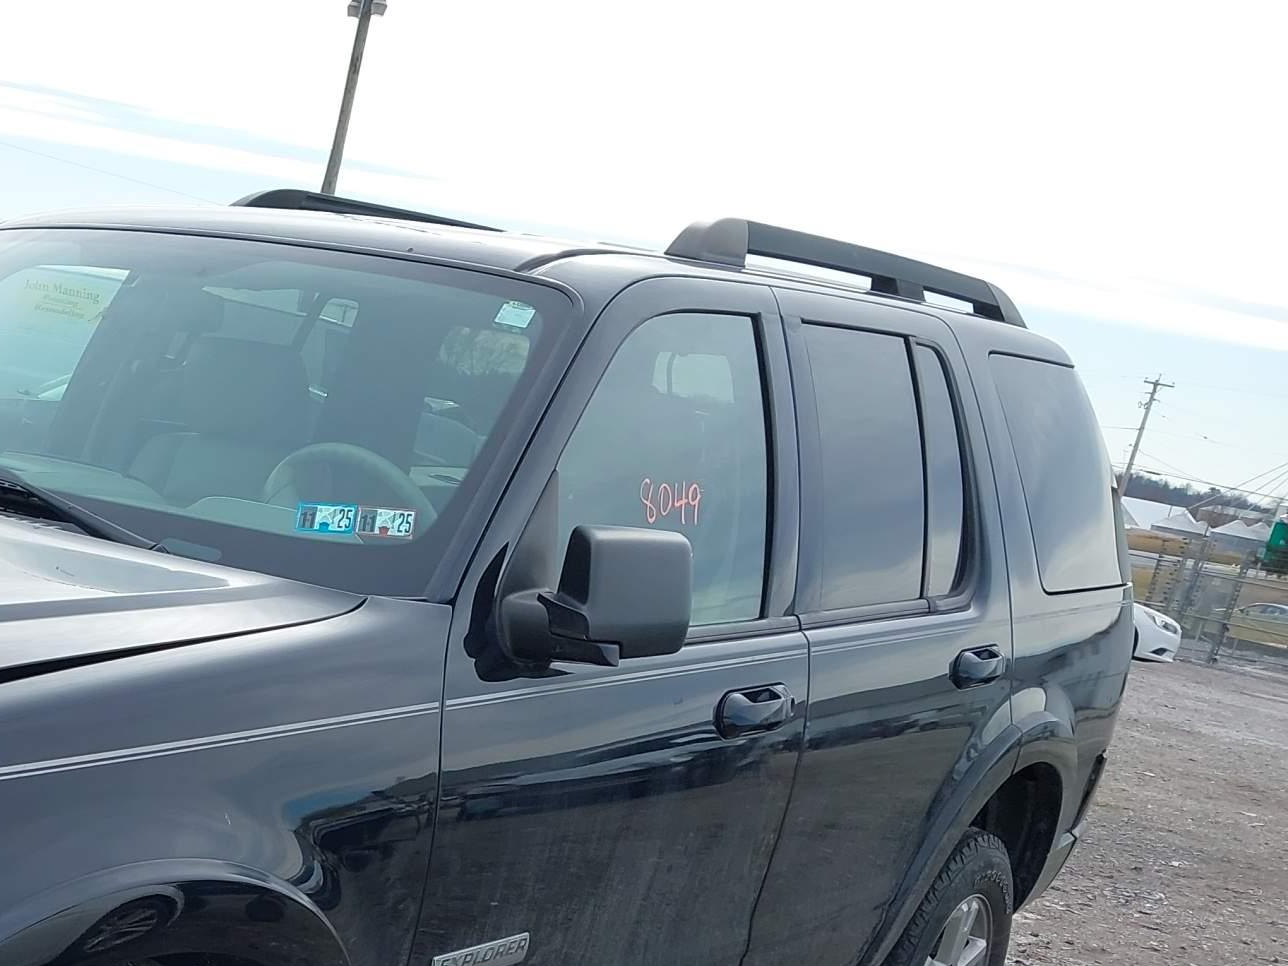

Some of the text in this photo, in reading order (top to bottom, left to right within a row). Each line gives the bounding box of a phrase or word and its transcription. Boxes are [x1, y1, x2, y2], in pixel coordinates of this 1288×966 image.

[53, 282, 100, 305] Manning
[639, 478, 703, 525] 8049
[337, 508, 353, 529] 25
[361, 512, 412, 533] 11 25
